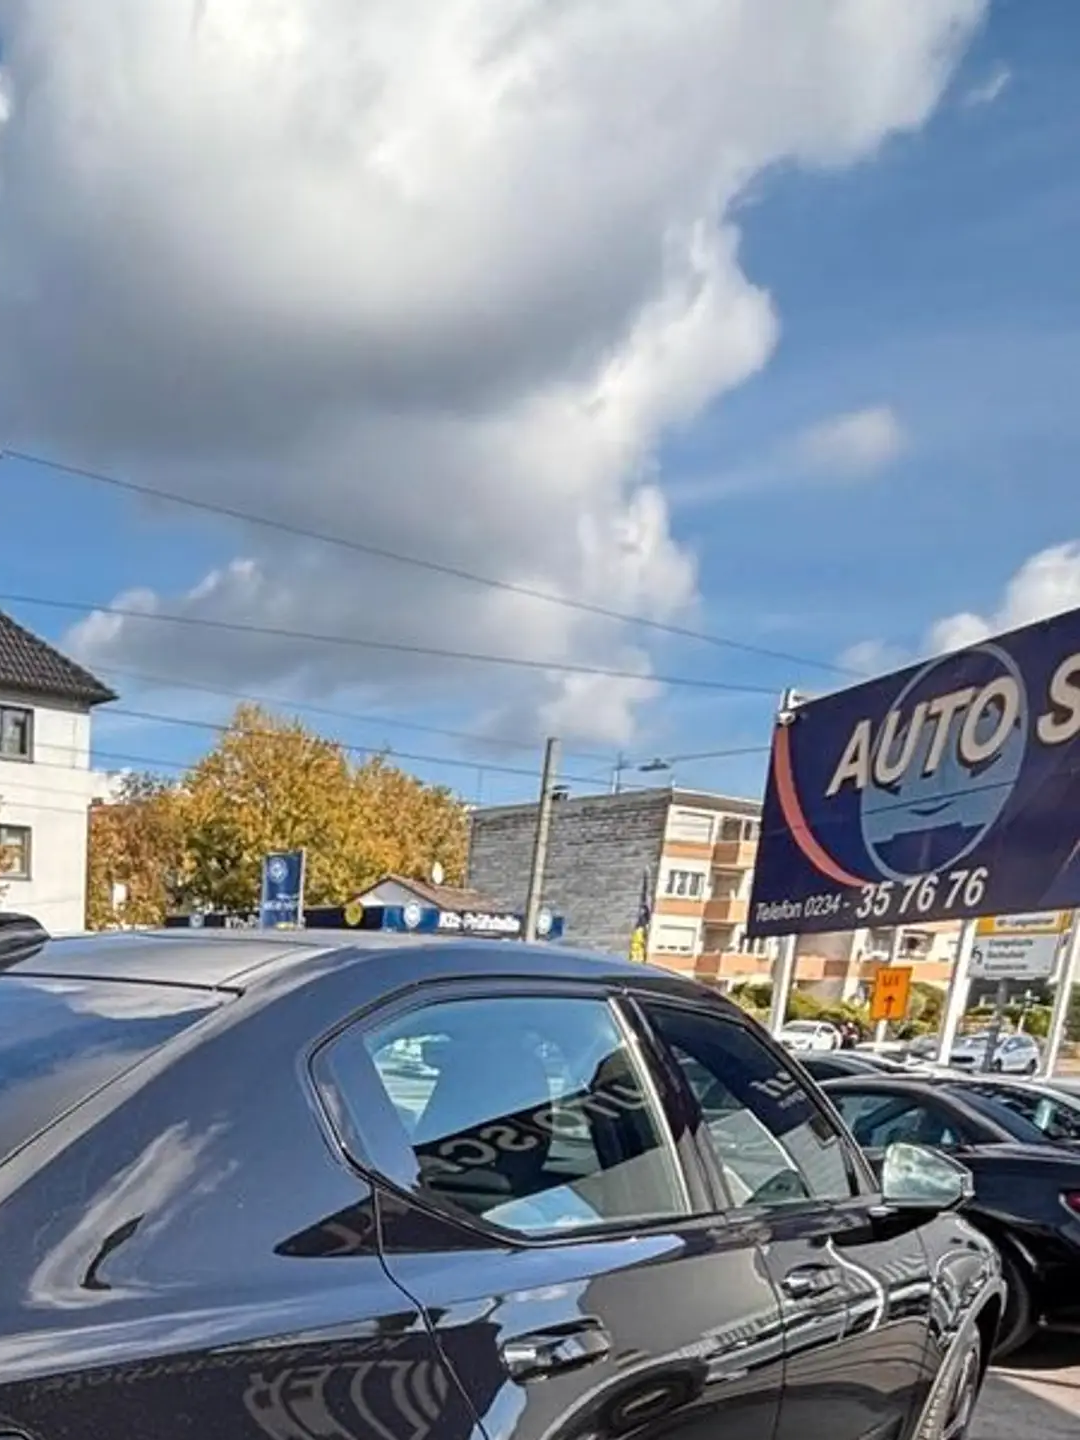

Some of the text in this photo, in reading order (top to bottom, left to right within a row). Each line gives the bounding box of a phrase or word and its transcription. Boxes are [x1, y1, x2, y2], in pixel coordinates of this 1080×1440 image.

[825, 676, 1020, 799] AUTO
[756, 899, 801, 922] Telefon
[804, 893, 842, 917] 0234
[856, 880, 894, 919] 35
[898, 874, 939, 914] 76
[945, 866, 988, 909] 76
